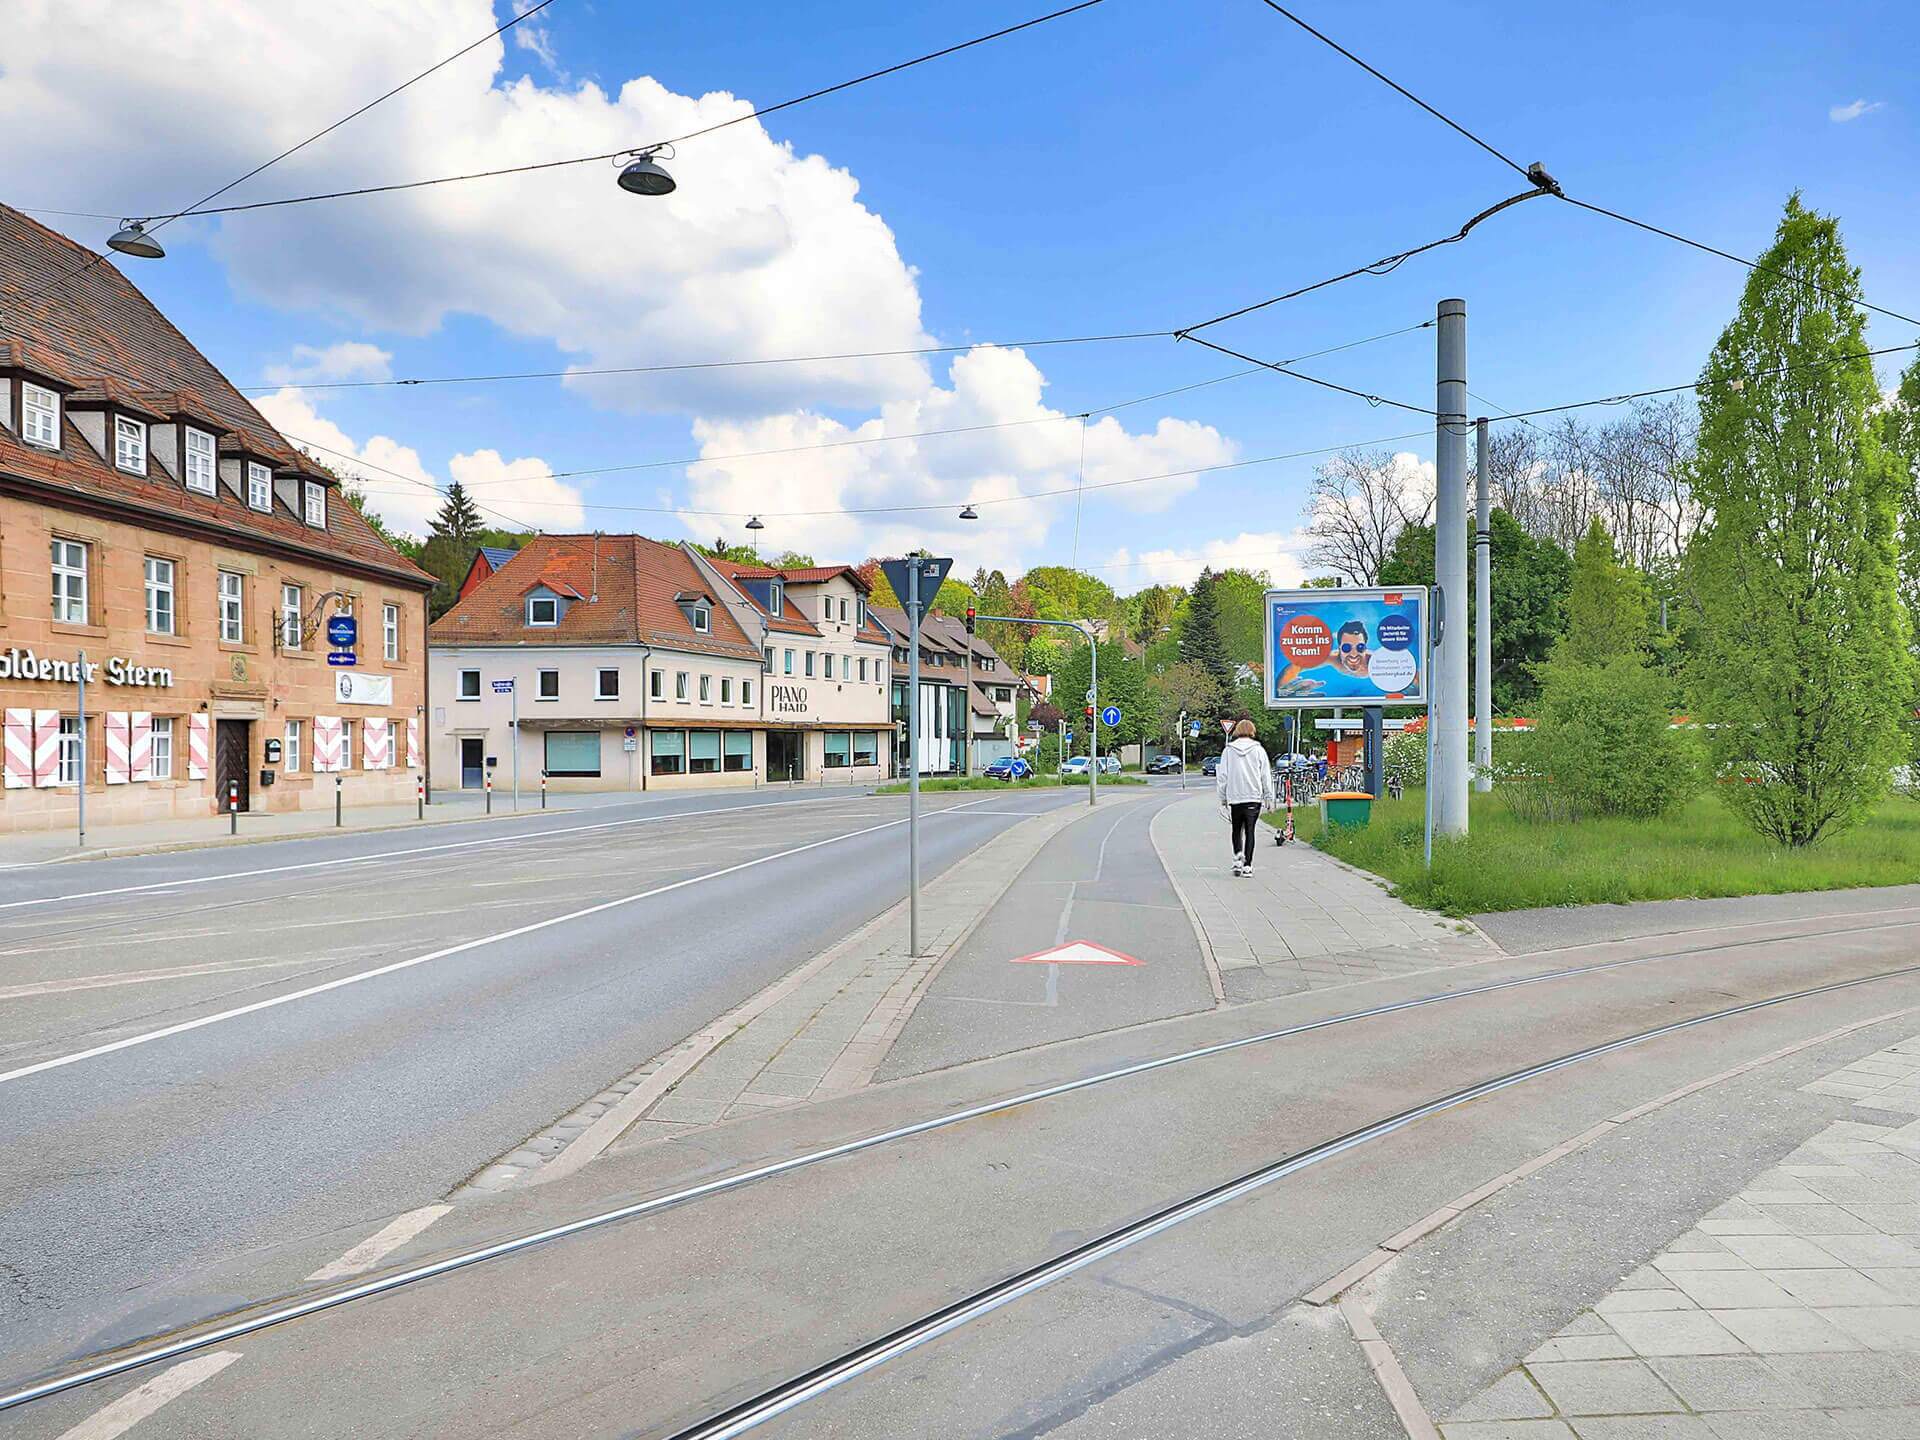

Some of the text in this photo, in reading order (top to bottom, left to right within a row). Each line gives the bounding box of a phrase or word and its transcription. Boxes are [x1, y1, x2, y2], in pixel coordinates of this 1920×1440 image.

[1291, 625, 1323, 635] Komm
[1282, 635, 1330, 645] zu uns ins
[1291, 646, 1321, 656] Team!
[108, 656, 174, 687] Stern
[771, 685, 808, 711] PIANO
[779, 702, 808, 712] HAID
